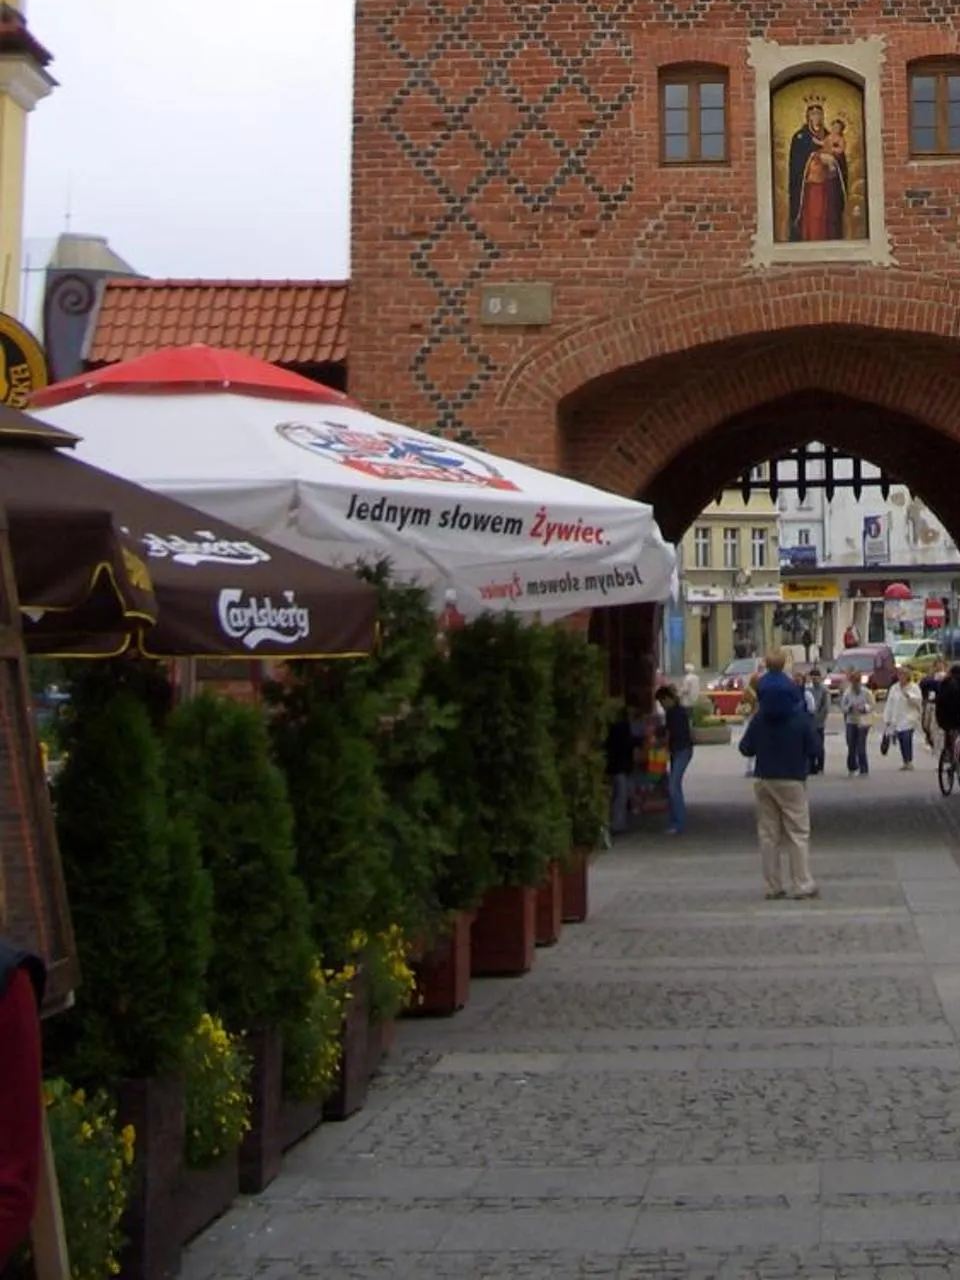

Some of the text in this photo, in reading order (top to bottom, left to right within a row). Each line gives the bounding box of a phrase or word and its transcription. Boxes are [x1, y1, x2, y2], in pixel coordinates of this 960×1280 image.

[347, 494, 612, 546] Jednym słowem Żywiec.
[218, 588, 309, 649] Carlsberg
